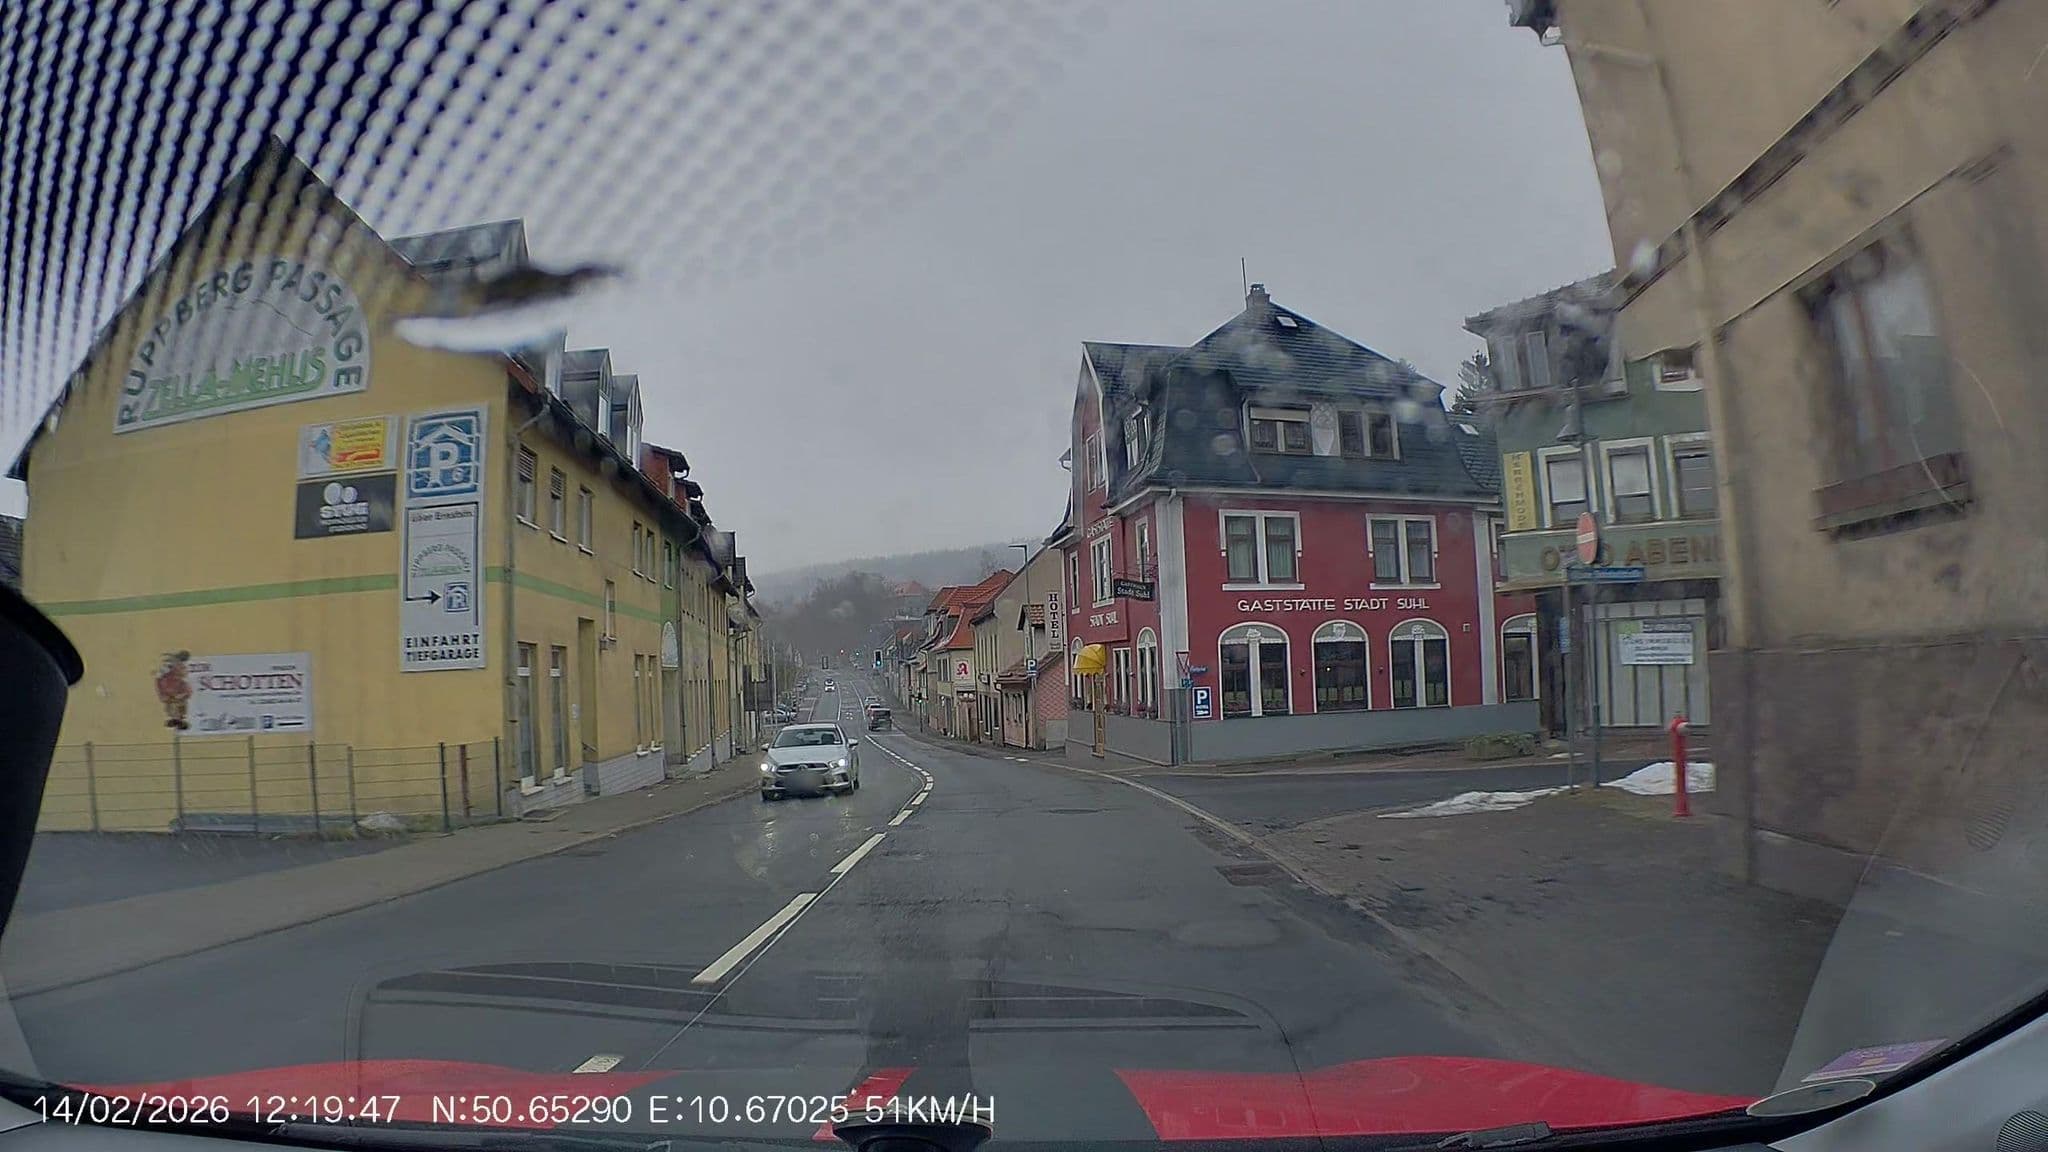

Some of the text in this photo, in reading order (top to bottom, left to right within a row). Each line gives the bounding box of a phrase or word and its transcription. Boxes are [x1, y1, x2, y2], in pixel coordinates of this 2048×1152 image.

[118, 260, 363, 425] RUPPBERG PASSAGE
[430, 442, 458, 483] P
[1343, 598, 1389, 611] STADT
[1397, 597, 1430, 610] SUHL
[1049, 593, 1060, 639] HOTEL
[405, 634, 479, 649] EINFAHRT
[405, 648, 479, 662] TIEFGARAGE
[198, 673, 304, 691] SCHOTTEN
[1196, 689, 1208, 704] P
